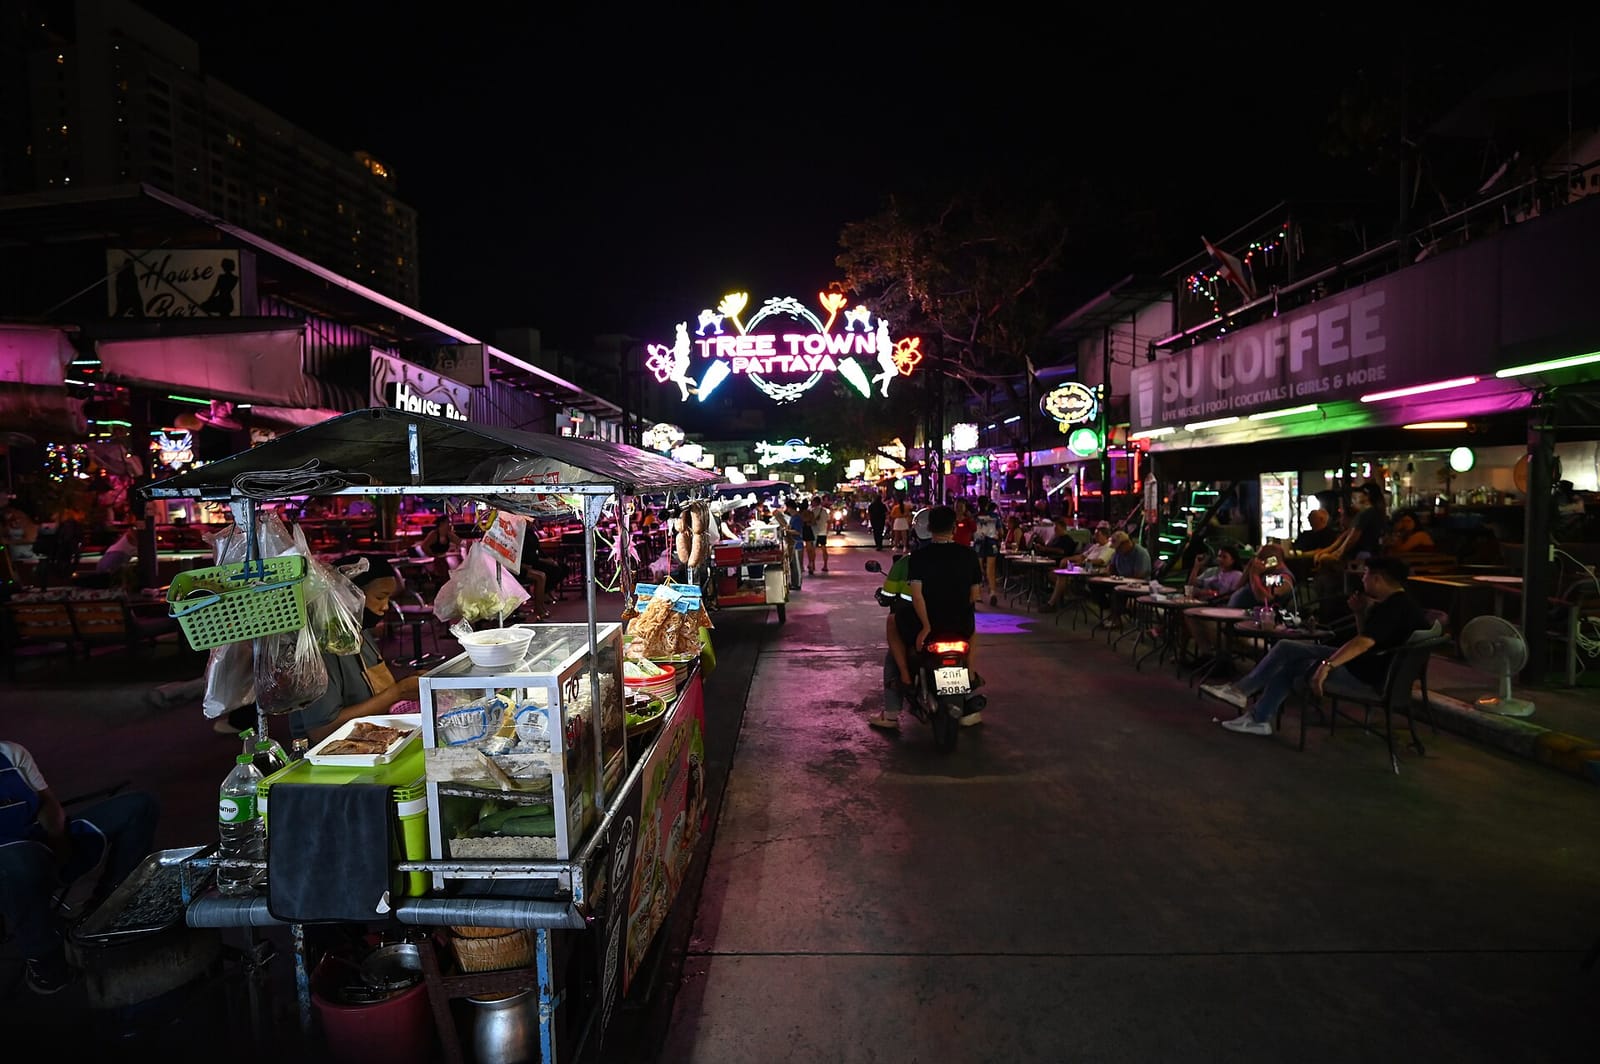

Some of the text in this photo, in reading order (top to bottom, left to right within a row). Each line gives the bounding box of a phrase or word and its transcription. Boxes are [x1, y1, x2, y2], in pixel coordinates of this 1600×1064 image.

[140, 254, 214, 291] House
[695, 332, 877, 358] TREE TOWN
[1162, 345, 1204, 403] SU
[1212, 291, 1386, 390] COFFEE
[732, 354, 838, 374] PATTAYA
[1162, 409, 1177, 422] LIVE
[1178, 404, 1201, 418] MUSIC
[1206, 398, 1228, 412] FOOD
[1234, 386, 1287, 407] COCKTAILS
[1296, 378, 1330, 395] GIRLS
[1333, 375, 1342, 388] &
[1346, 366, 1386, 385] MORE
[566, 676, 579, 703] 70
